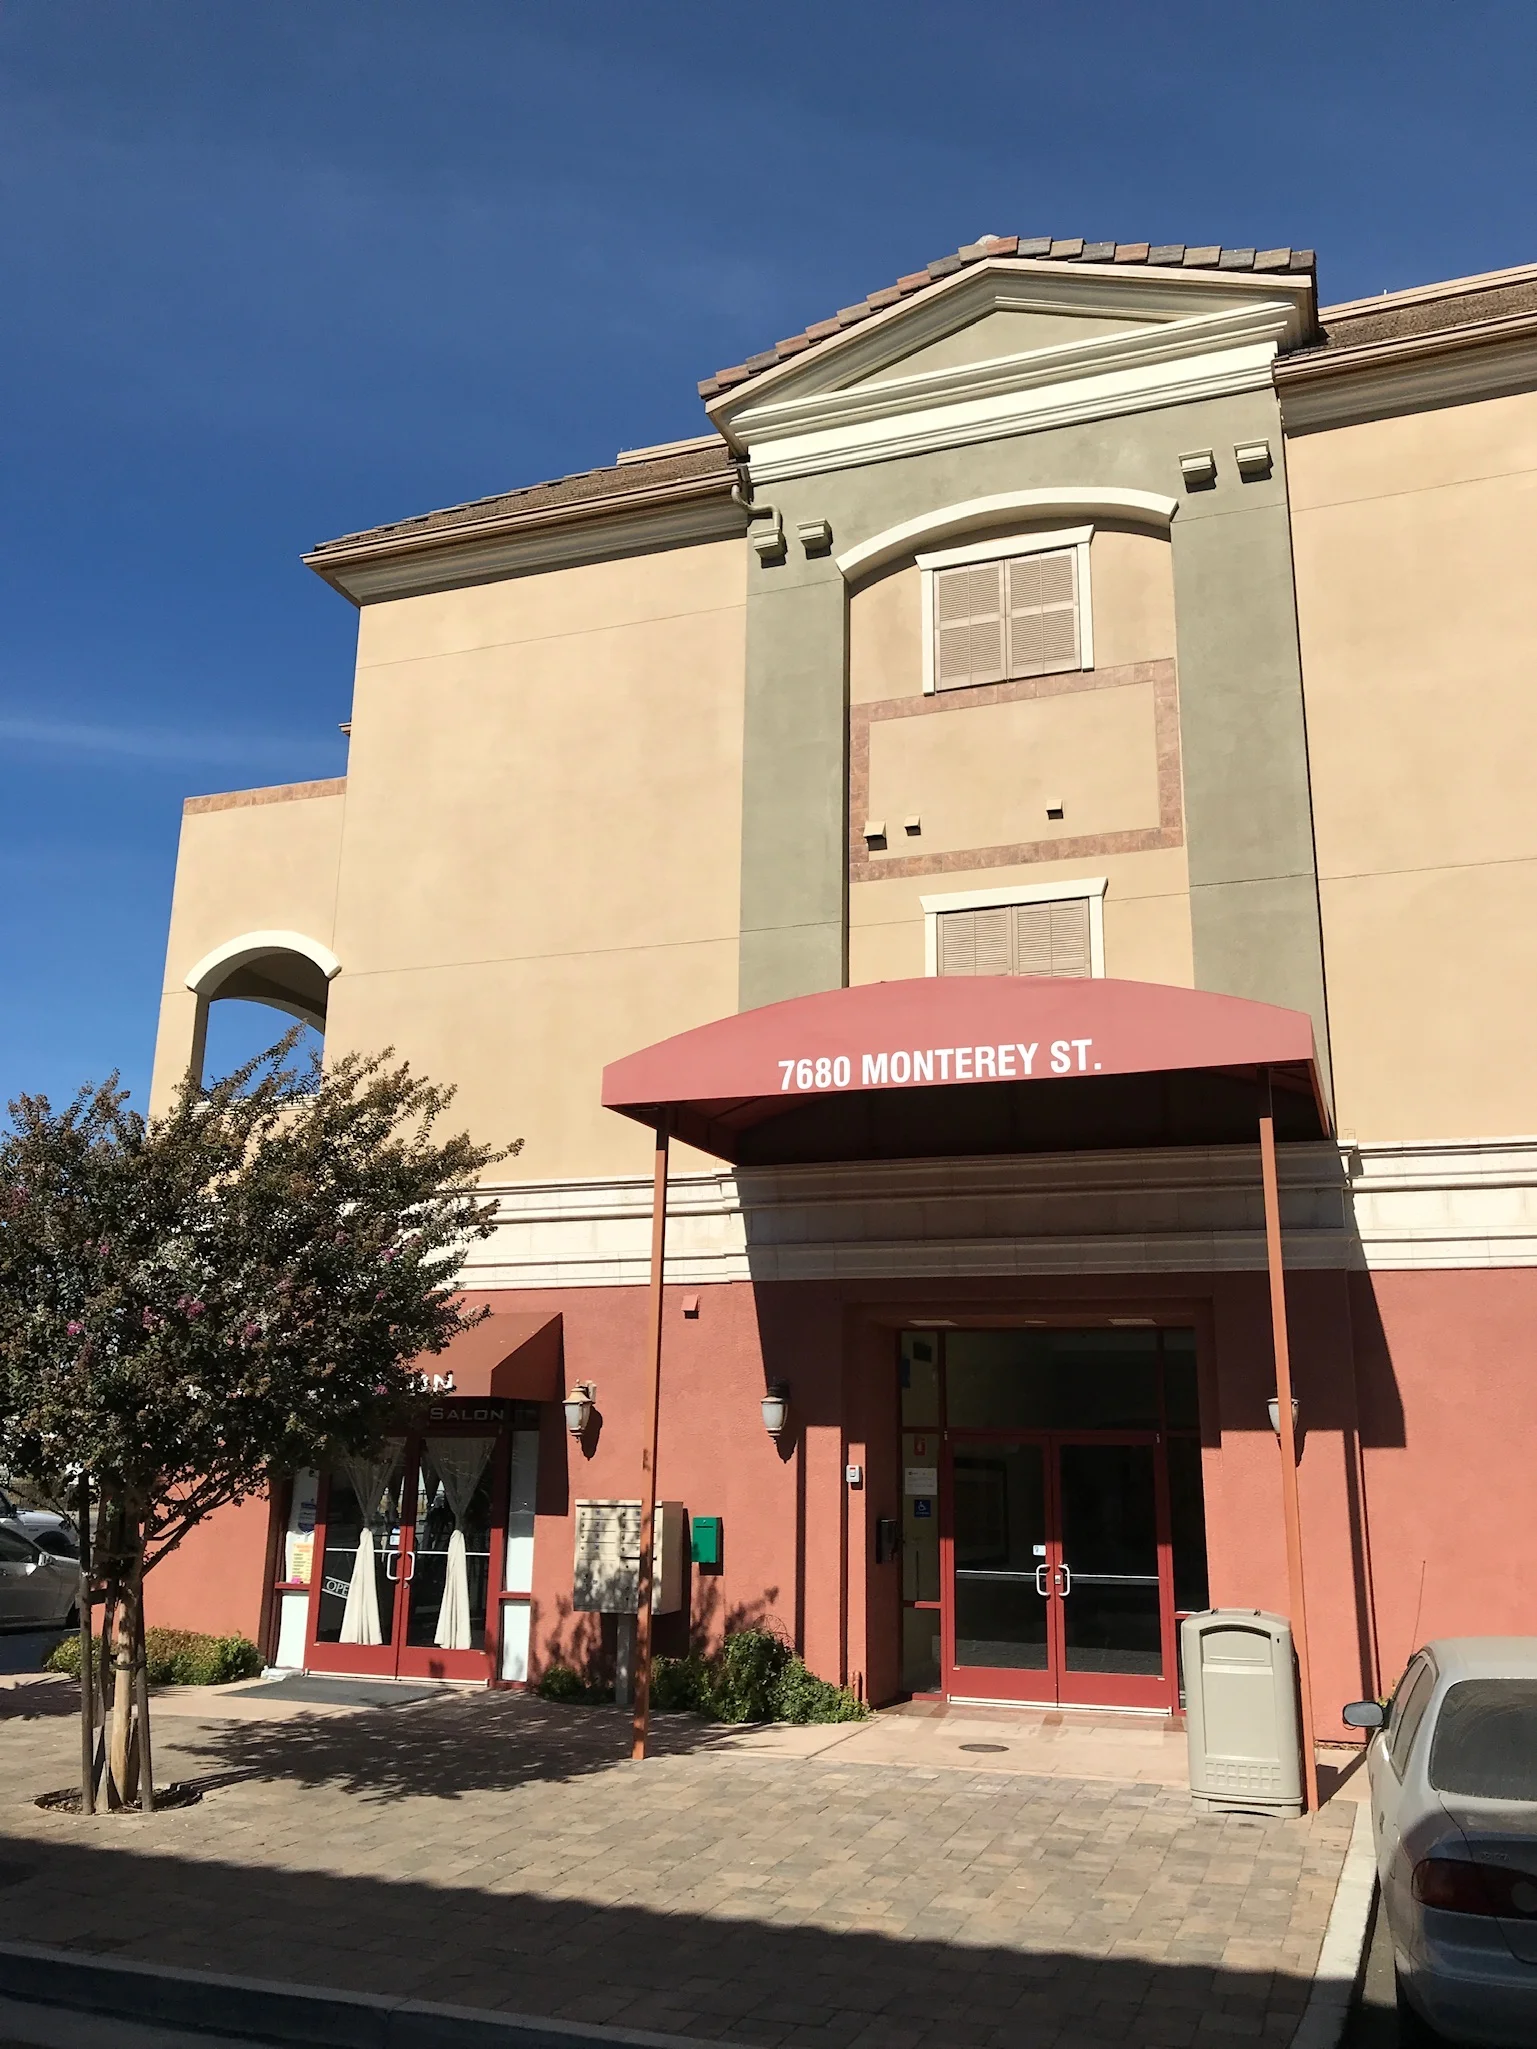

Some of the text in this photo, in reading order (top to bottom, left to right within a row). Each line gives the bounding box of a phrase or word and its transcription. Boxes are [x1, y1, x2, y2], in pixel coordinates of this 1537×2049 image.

[778, 1039, 1102, 1091] 7680 MONTEREY ST.
[430, 1407, 504, 1421] SALON
[326, 1580, 350, 1595] OPE
